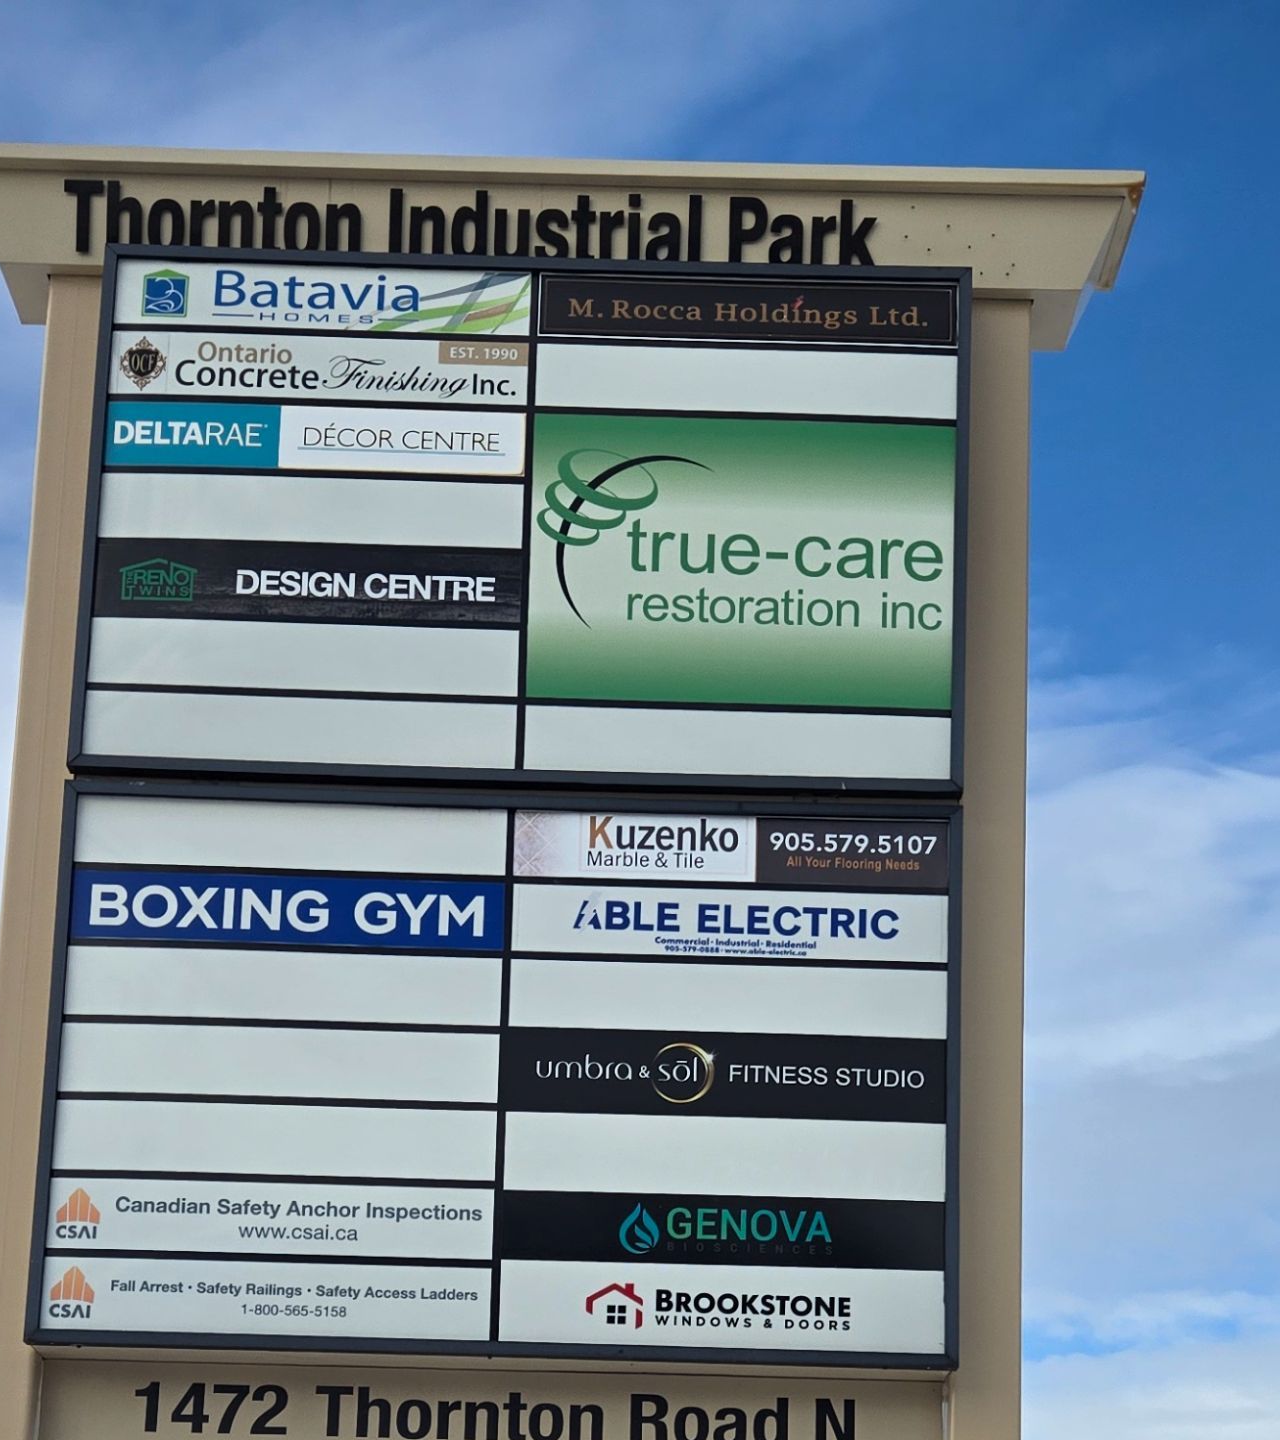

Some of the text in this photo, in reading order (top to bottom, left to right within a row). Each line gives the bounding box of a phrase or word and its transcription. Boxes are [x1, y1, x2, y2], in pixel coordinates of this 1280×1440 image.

[64, 179, 878, 266] Thornton Industrial Park
[213, 270, 420, 312] Batavia
[259, 312, 374, 324] HOMES
[568, 297, 928, 329] M. Rocca Holdings Ltd.
[131, 353, 155, 373] OCF
[198, 341, 292, 365] Ontario
[449, 346, 518, 361] EST. 1990
[175, 355, 517, 398] Concrete Finishing Inc.
[114, 421, 263, 447] DELTARAE
[303, 423, 500, 452] DÉCOR CENTRE
[627, 518, 944, 582] true-care
[134, 569, 189, 586] RENO
[236, 569, 496, 602] DESIGN CENTRE
[127, 586, 190, 598] TWINS
[627, 587, 942, 631] restoration inc
[589, 815, 739, 852] Kuzenko
[769, 832, 937, 856] 905.579.5107
[587, 850, 704, 869] Marble & Tile
[786, 856, 920, 872] All Your Flooring Needs
[89, 883, 485, 938] BOXING GYM
[573, 900, 899, 939] ABLE ELECTRIC
[655, 936, 817, 950] Commercial Industrial Residential
[536, 1054, 632, 1081] umbra
[639, 1065, 650, 1079] &
[729, 1065, 828, 1085] FITNESS
[835, 1068, 925, 1089] STUDIO
[115, 1196, 482, 1223] Canadian Safety Anchor Inspections
[238, 1224, 358, 1241] www.csai.ca
[666, 1208, 832, 1243] GENOVA
[111, 1280, 478, 1302] Fall Arrest Safety Railings Safety Access Ladders
[655, 1289, 851, 1318] BROOKSTONE
[242, 1304, 347, 1318] 1-800-565-5158
[655, 1315, 850, 1331] WINDOWS & DOORS
[134, 1382, 288, 1436] 1472
